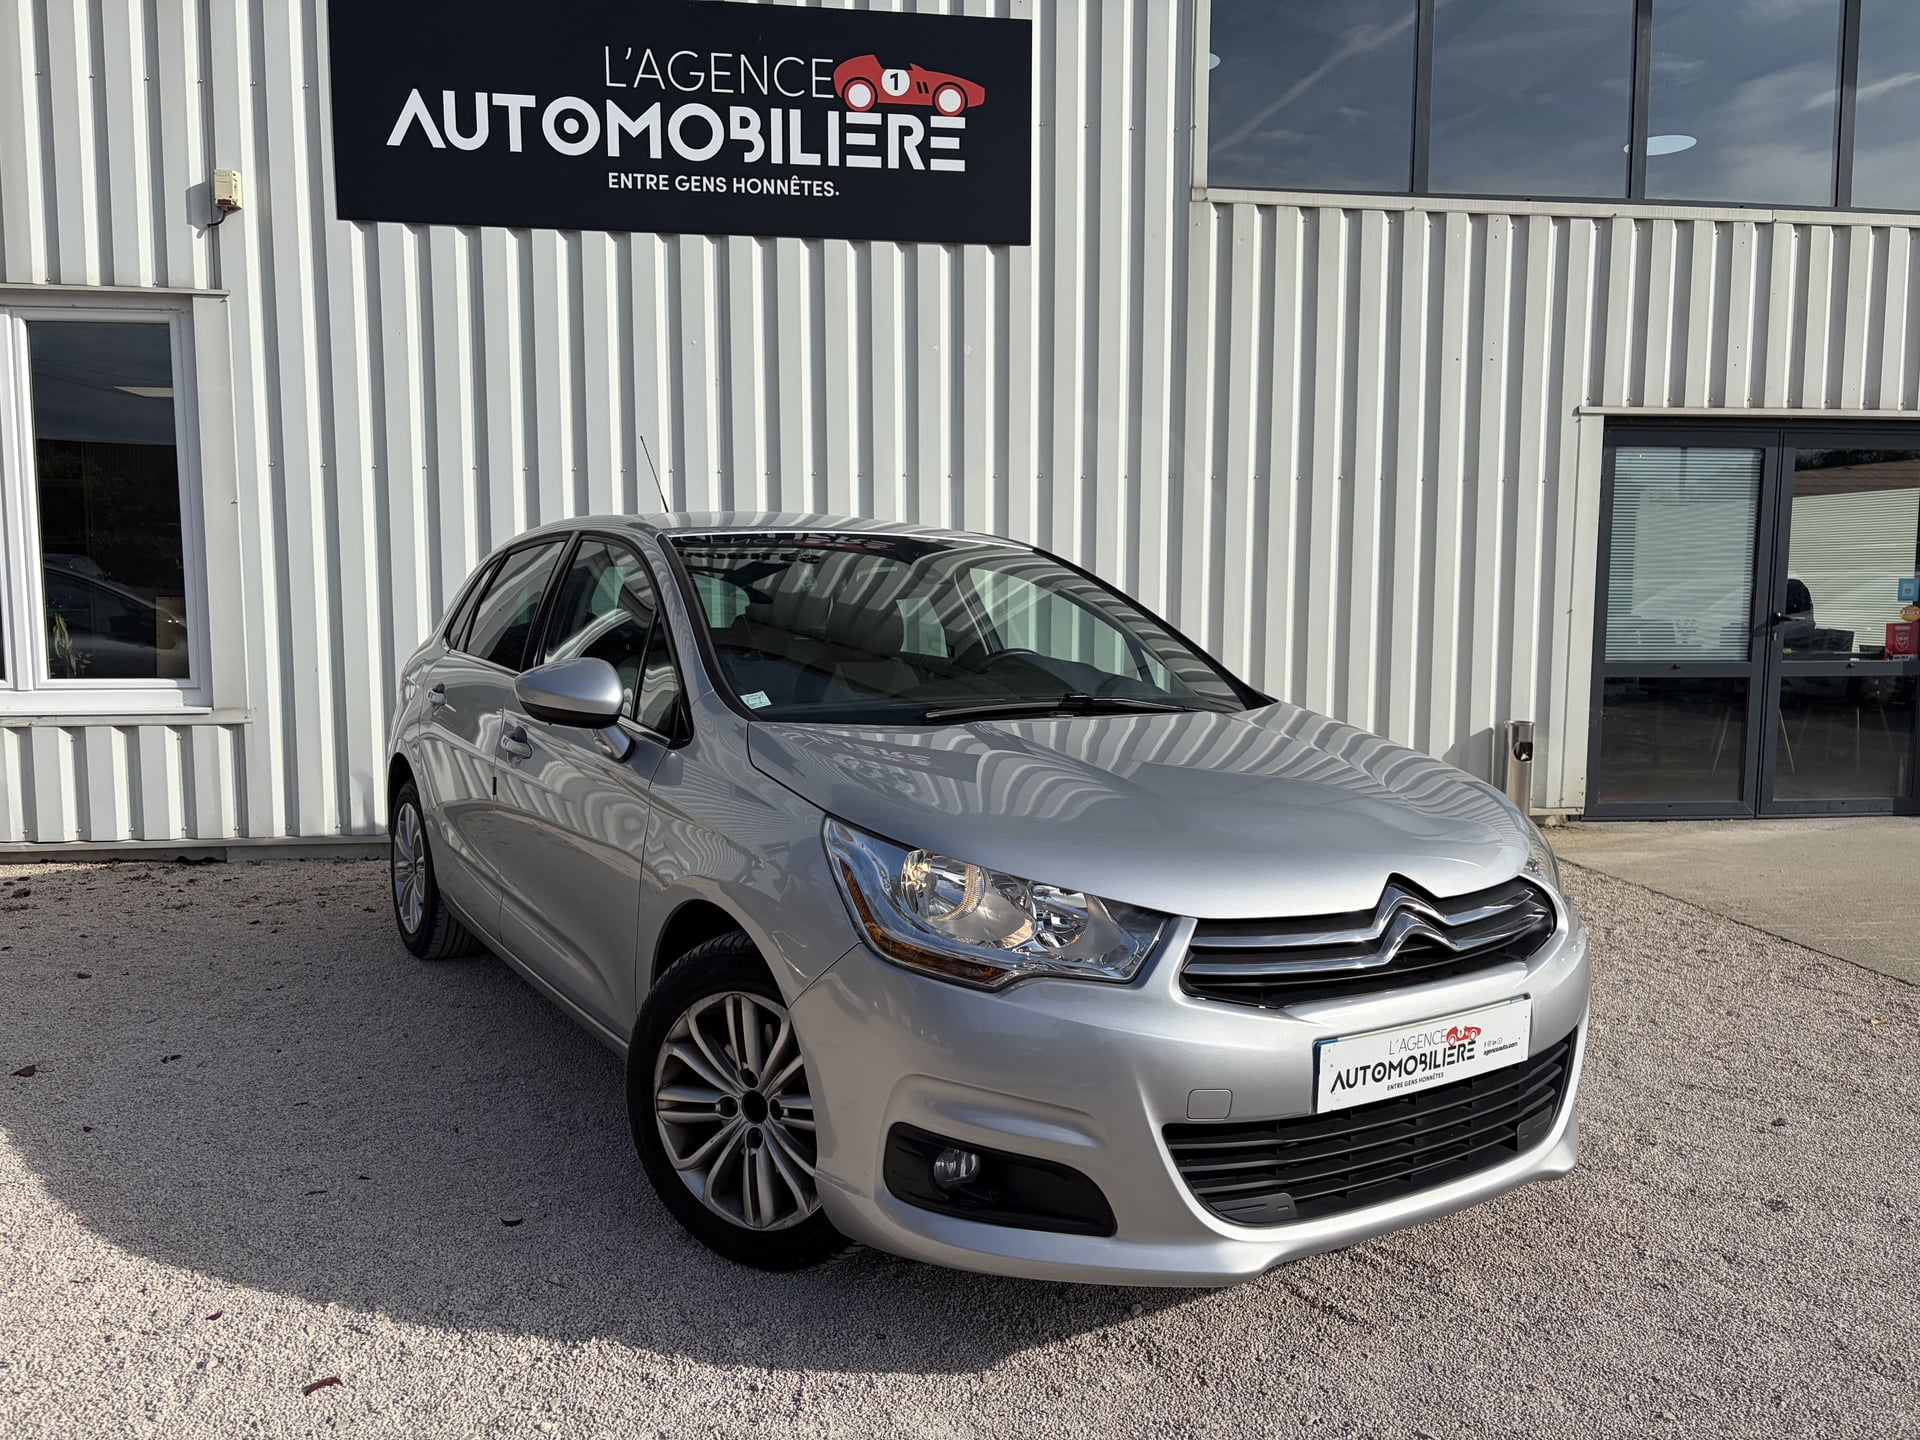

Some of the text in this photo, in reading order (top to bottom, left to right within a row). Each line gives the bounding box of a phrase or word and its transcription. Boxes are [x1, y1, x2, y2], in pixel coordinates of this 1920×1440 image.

[604, 45, 835, 99] L'AGENCE
[889, 72, 899, 91] 1
[386, 87, 966, 173] AUTOMOBILIERE
[608, 172, 840, 198] ENTRE GENS HONNÊTES.
[1388, 1028, 1448, 1056] L'AGENCE
[1386, 1071, 1445, 1092] ENTRE GENS HONNÊTES
